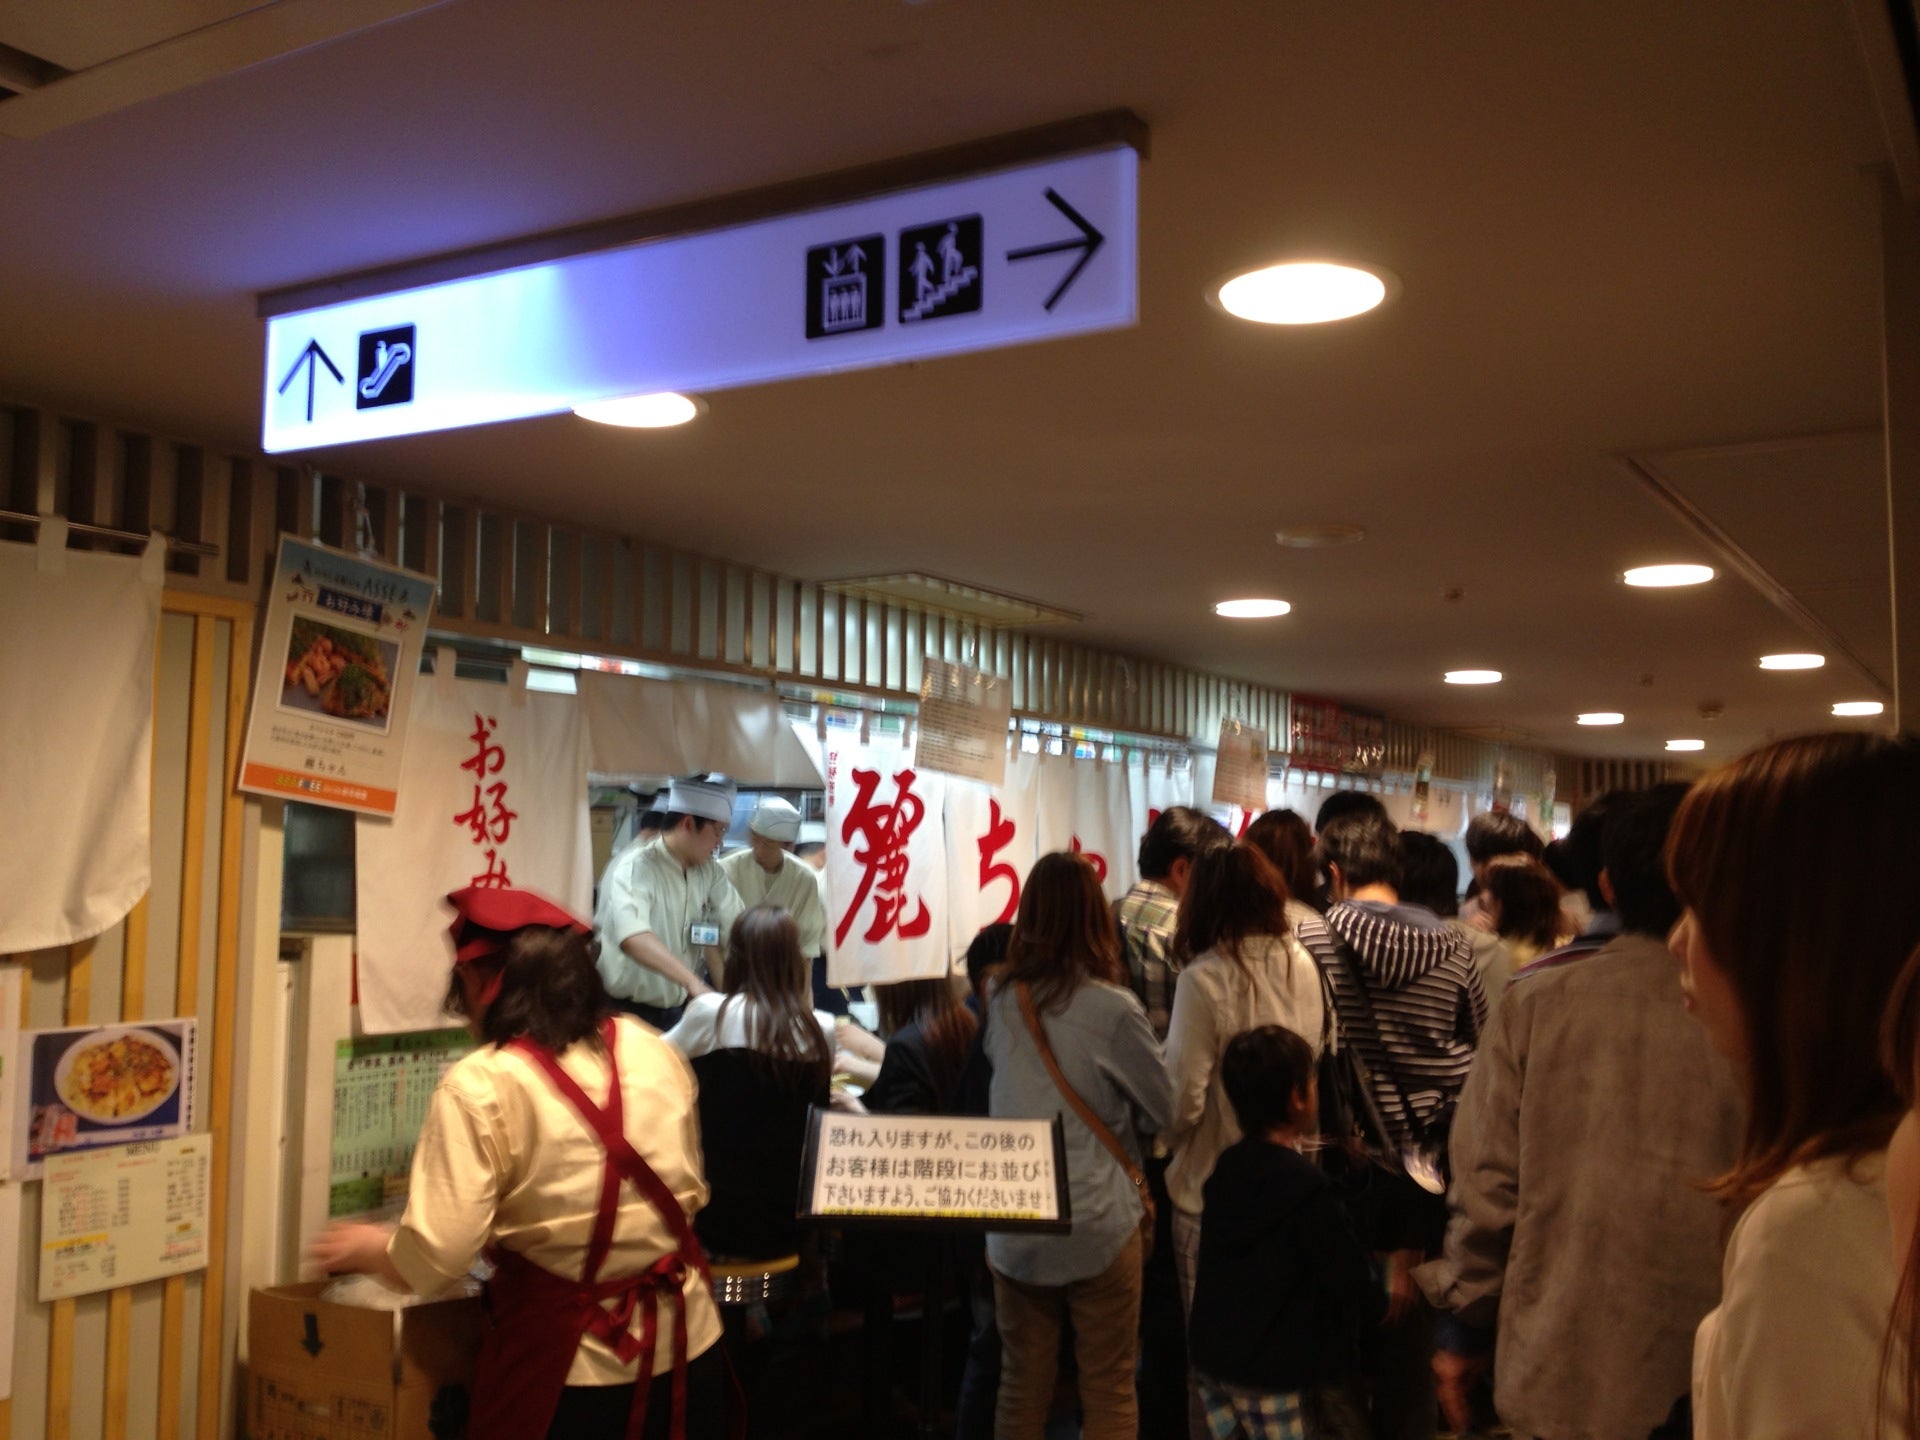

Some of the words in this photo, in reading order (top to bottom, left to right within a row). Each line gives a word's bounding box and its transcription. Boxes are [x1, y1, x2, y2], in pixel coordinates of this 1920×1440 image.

[826, 1156, 1042, 1182] お客様は階段にお並び
